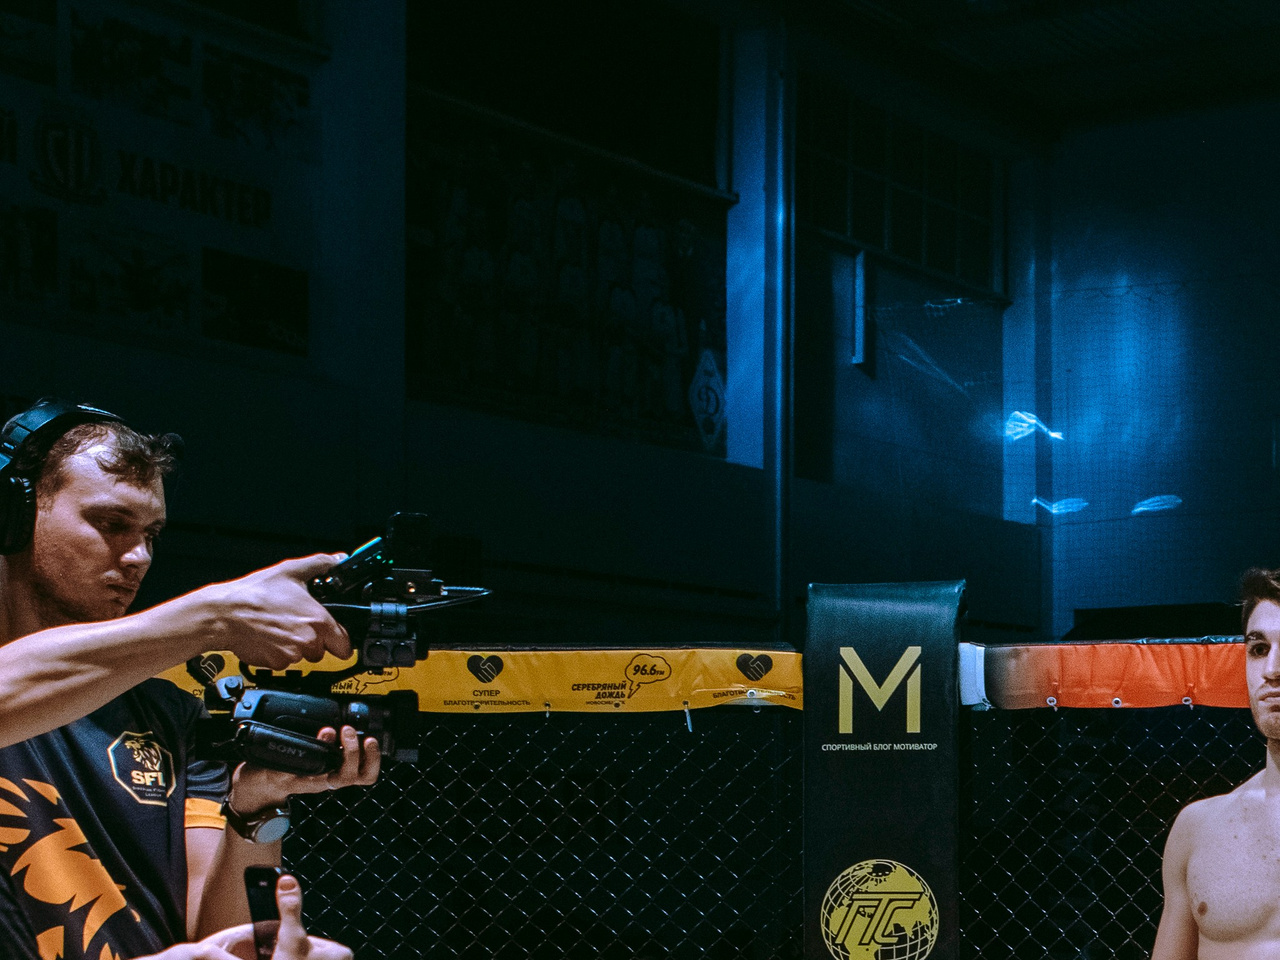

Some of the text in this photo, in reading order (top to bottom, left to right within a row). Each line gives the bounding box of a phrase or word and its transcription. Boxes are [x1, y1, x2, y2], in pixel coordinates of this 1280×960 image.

[572, 681, 626, 691] СЕРЕБРЯНЫЙ
[472, 689, 501, 697] СУПЕР
[595, 691, 626, 700] ДОЖДЬ
[268, 742, 307, 757] SONY
[821, 742, 938, 751] СПОРТИВНЫЙ БЛОГ МОТИВАТОР
